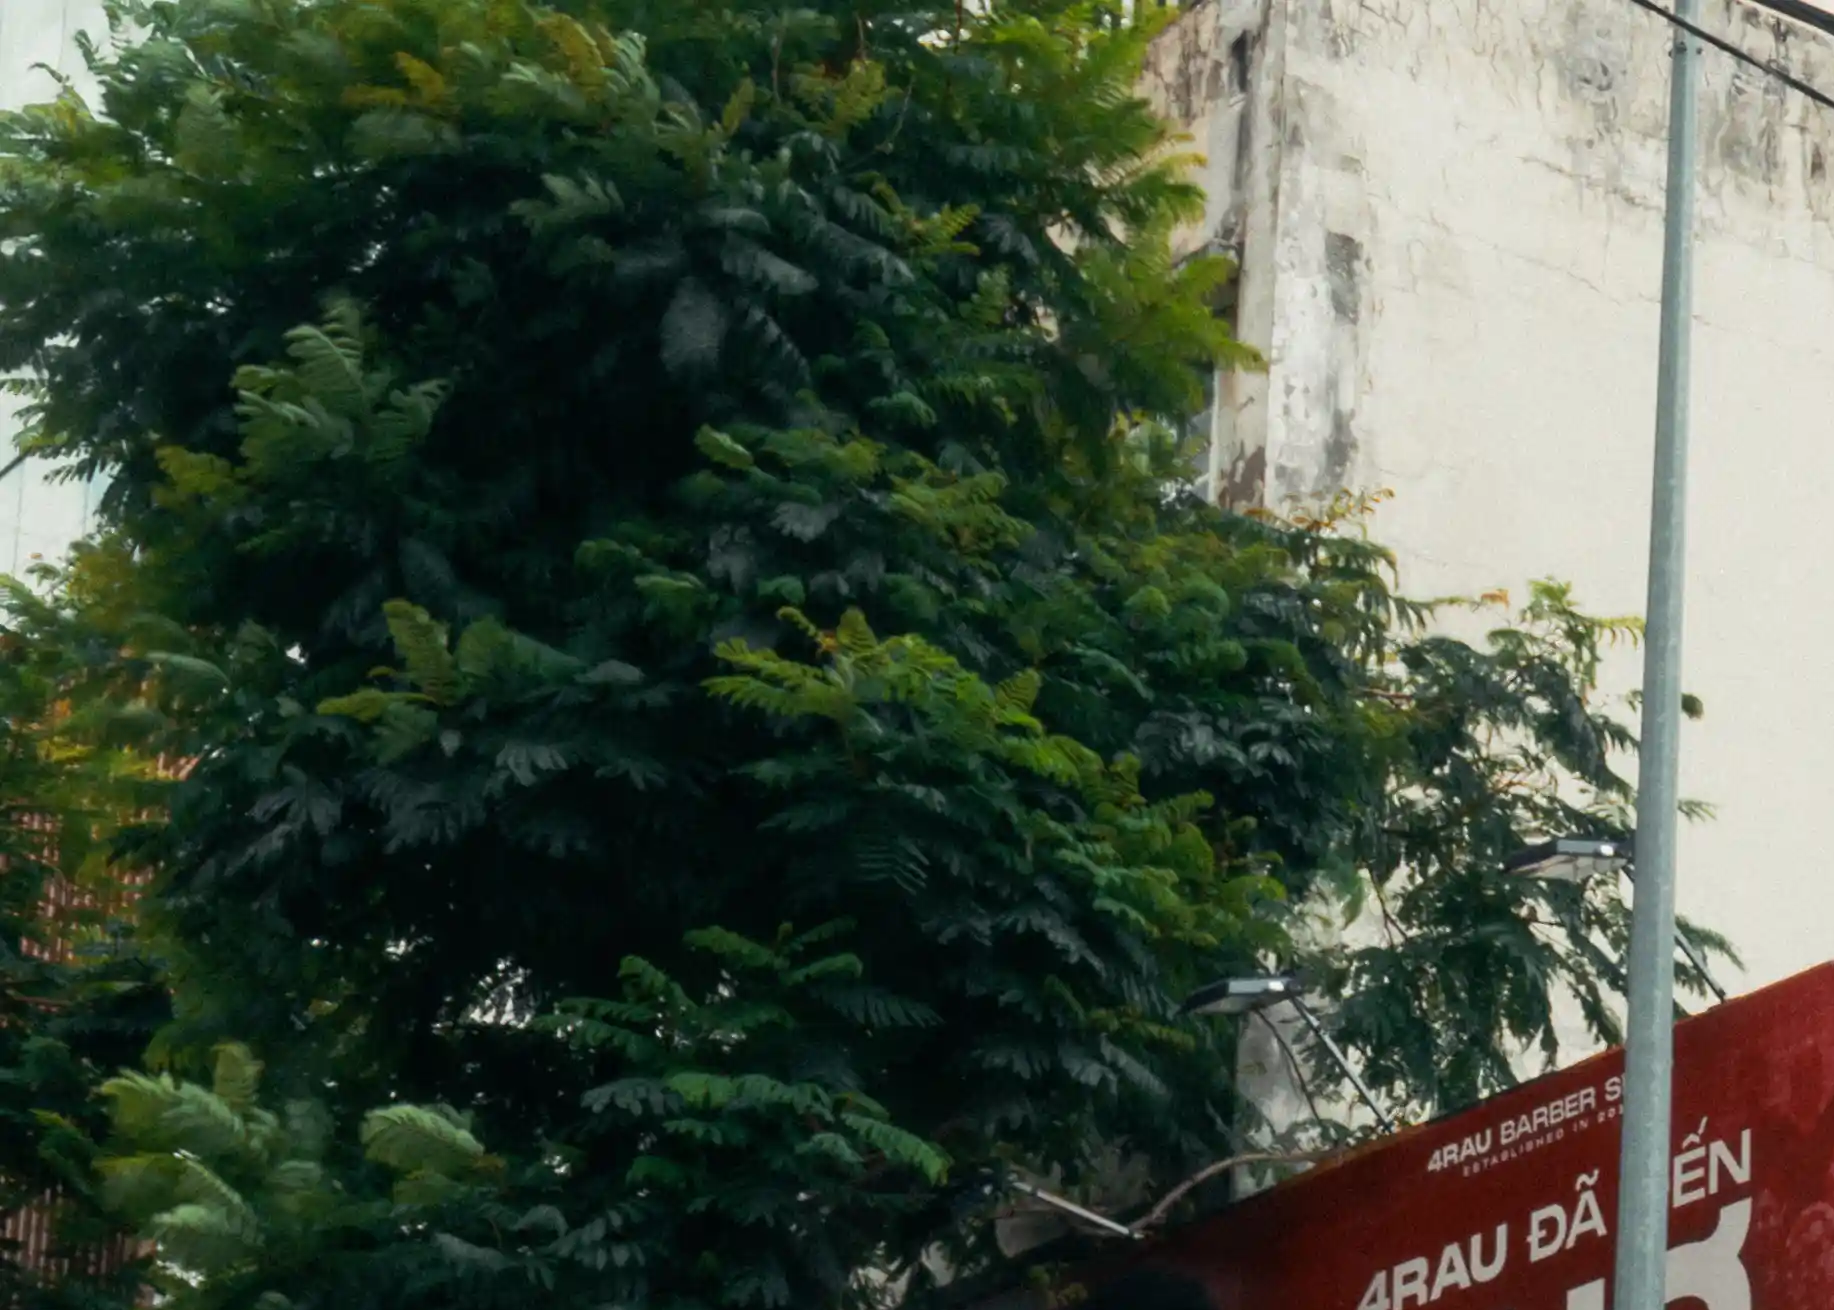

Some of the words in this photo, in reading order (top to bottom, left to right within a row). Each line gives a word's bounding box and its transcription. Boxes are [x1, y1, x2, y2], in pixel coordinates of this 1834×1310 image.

[1427, 1128, 1492, 1172] 4RAU
[1499, 1086, 1596, 1144] BARBER
[1597, 1104, 1624, 1123] 201
[1528, 1168, 1606, 1263] ĐÃ
[1672, 1116, 1752, 1208] ẾN
